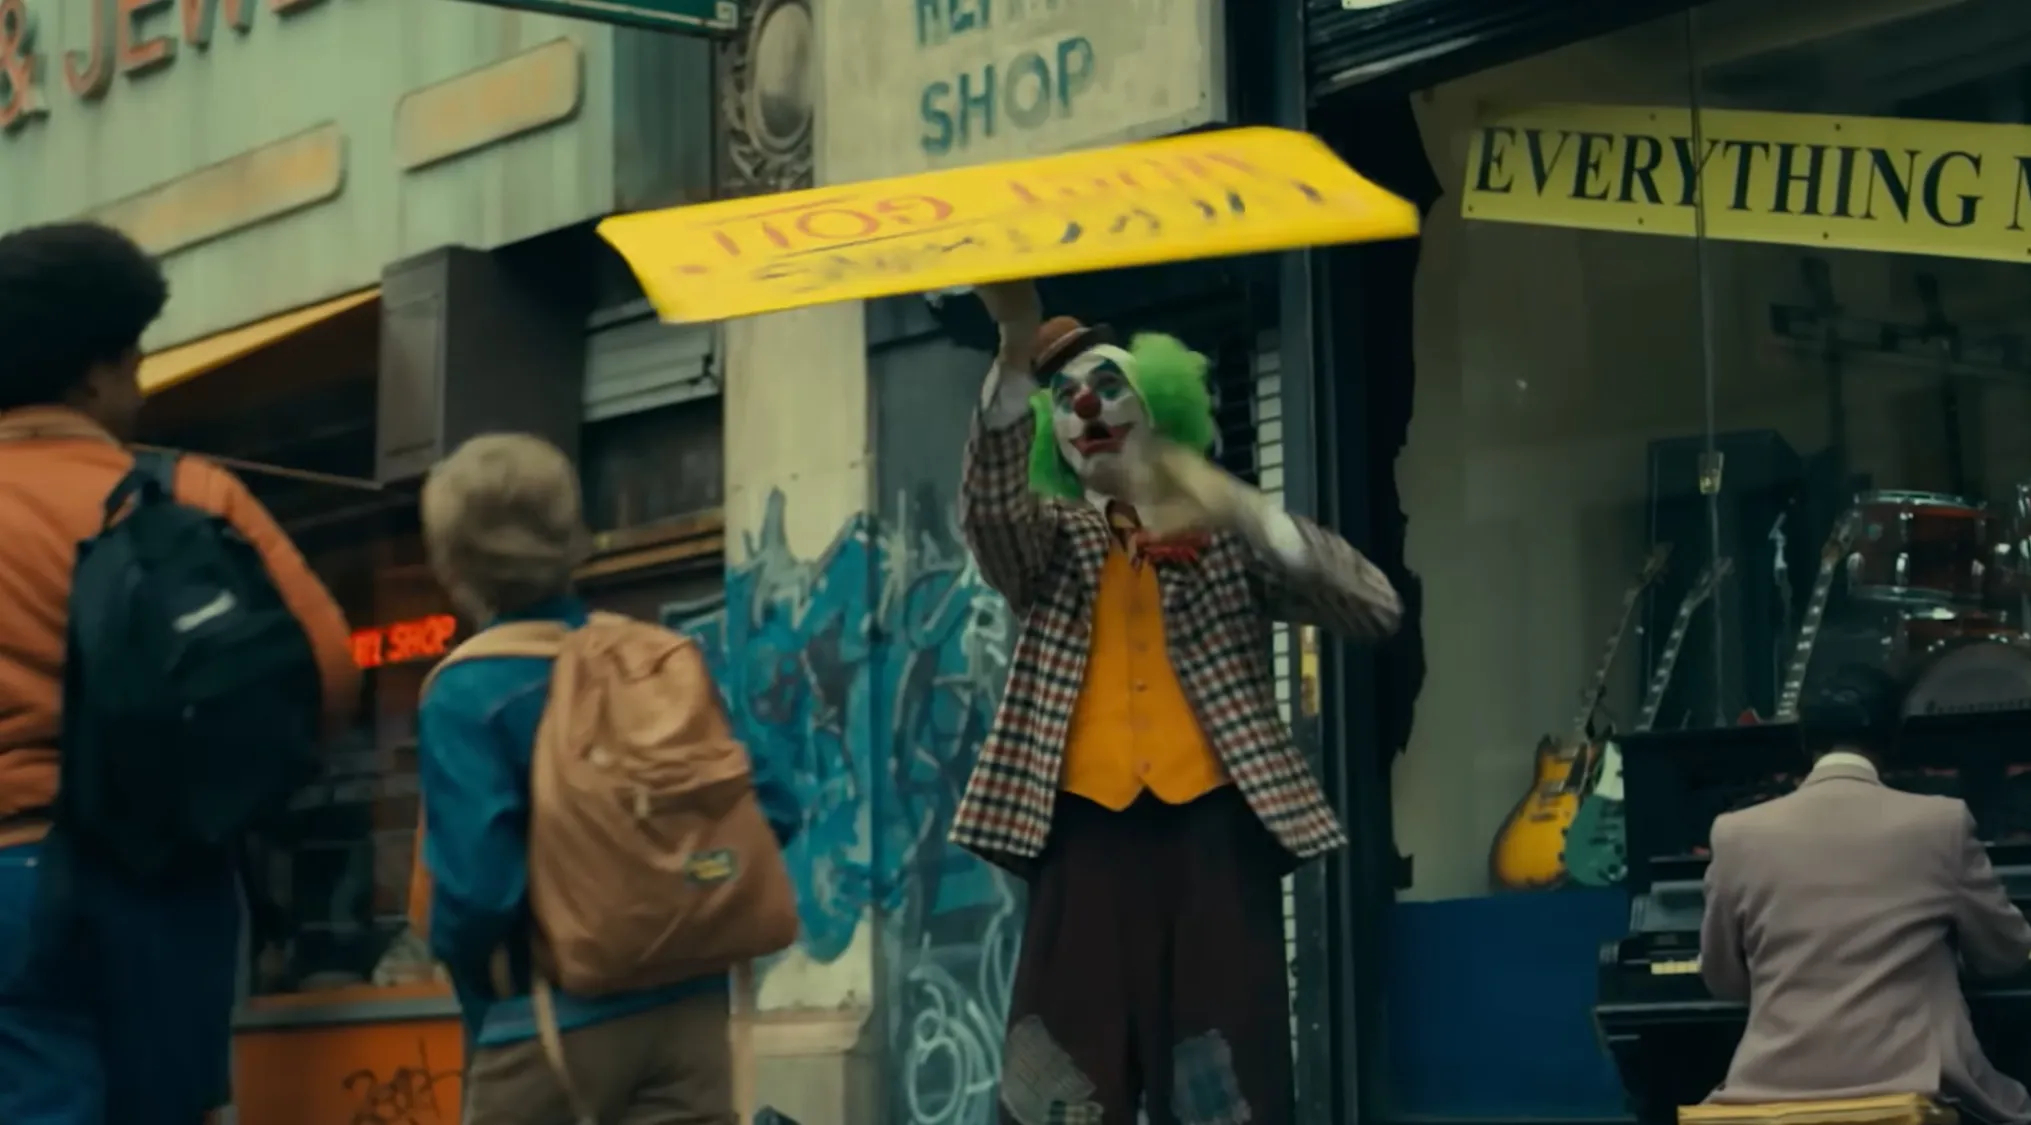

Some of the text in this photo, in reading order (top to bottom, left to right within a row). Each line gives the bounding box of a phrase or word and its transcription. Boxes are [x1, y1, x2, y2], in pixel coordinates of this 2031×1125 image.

[63, 0, 333, 103] JE
[919, 36, 1096, 157] SHOP
[1472, 126, 1984, 228] EVERYTHING
